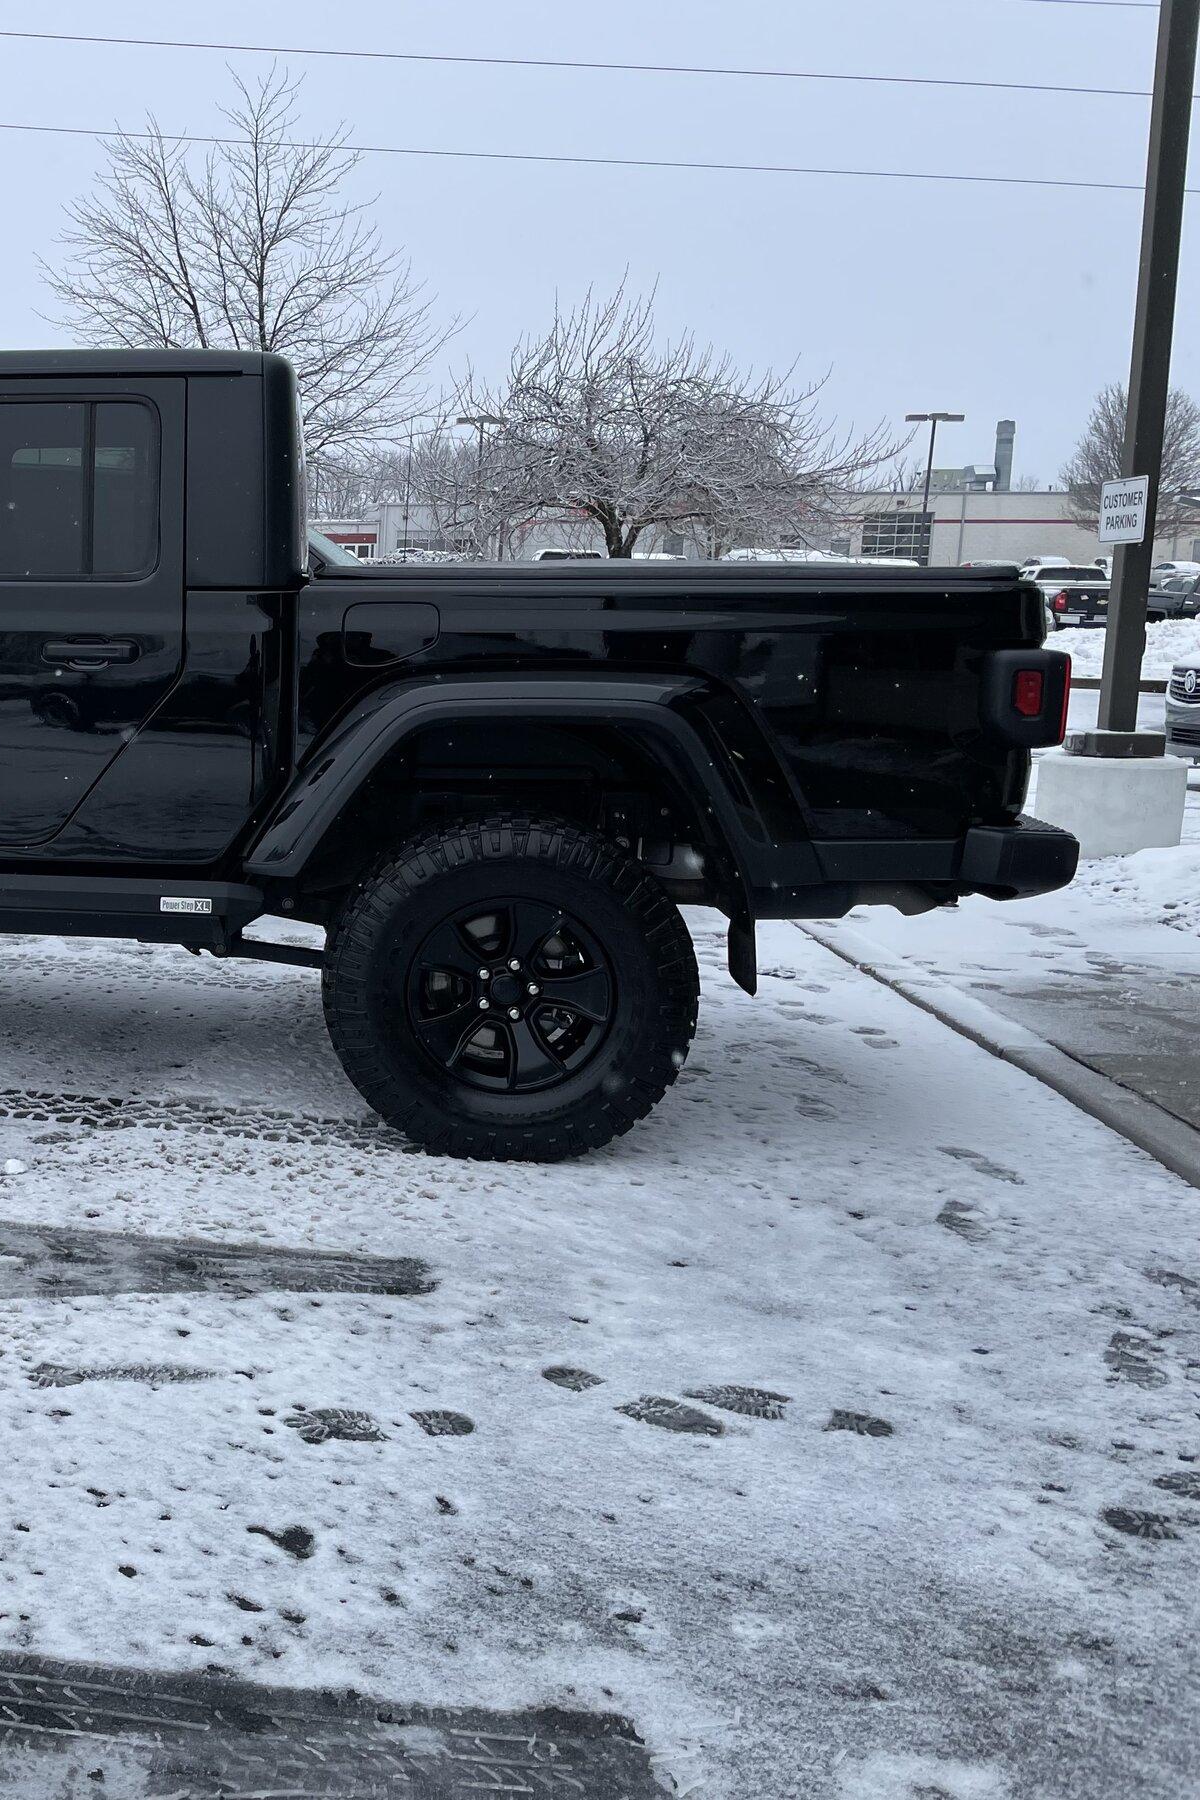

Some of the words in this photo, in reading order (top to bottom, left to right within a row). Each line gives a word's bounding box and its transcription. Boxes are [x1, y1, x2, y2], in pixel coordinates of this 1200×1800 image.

[1104, 491, 1143, 509] CUSTOMER
[1106, 514, 1137, 530] PARKING
[195, 901, 210, 911] XL
